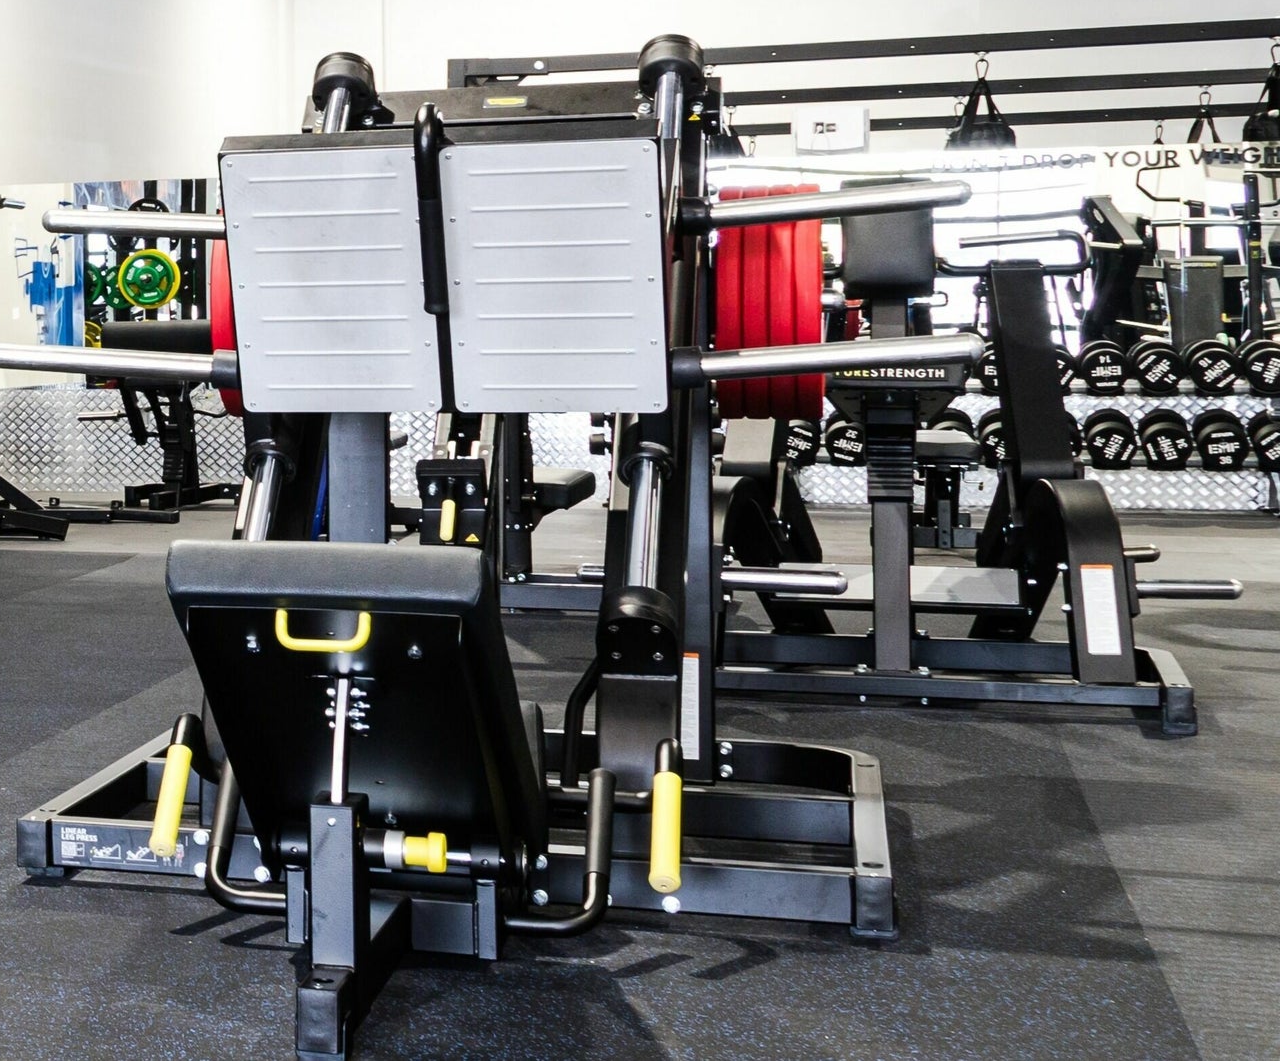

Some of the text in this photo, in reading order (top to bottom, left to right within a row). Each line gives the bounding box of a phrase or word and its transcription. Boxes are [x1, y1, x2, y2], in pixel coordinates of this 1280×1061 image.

[1103, 148, 1179, 168] YOUR
[1098, 355, 1112, 364] 14
[1090, 364, 1123, 378] EMF
[1144, 358, 1171, 384] EMF
[1163, 373, 1178, 385] 14
[1203, 359, 1231, 384] EMF
[786, 435, 813, 451] EMF
[832, 438, 864, 454] EMF
[1103, 433, 1125, 460] EMF
[1156, 434, 1179, 462] EMF
[1207, 441, 1241, 456] EMF
[60, 826, 87, 835] LINEAR
[60, 833, 99, 843] LEG PRESS
